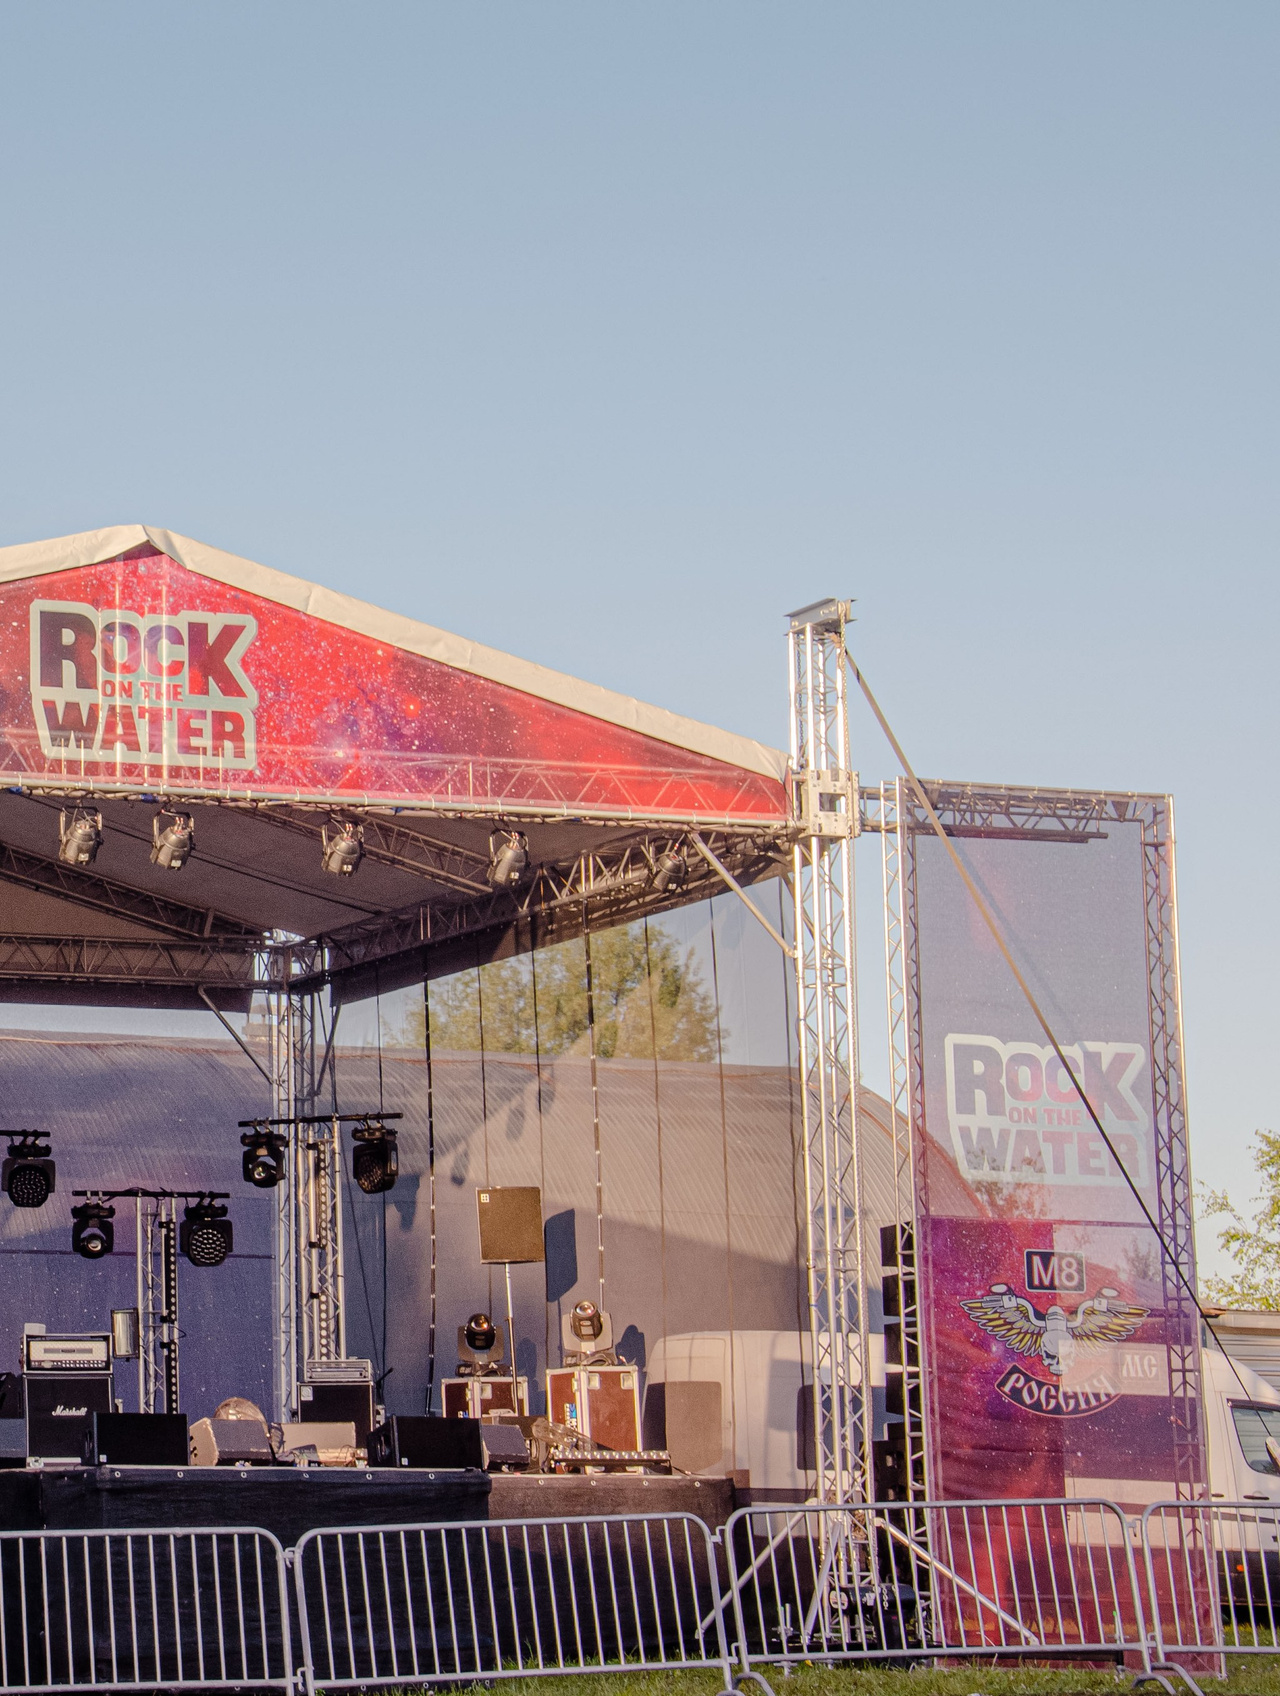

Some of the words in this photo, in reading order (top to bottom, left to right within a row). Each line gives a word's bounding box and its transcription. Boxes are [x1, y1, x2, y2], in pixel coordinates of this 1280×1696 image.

[39, 610, 246, 698] ROCK
[102, 679, 133, 699] ON
[140, 681, 184, 702] THE
[43, 700, 246, 759] WATER
[954, 1045, 1138, 1122] ROCK
[1008, 1106, 1038, 1125] ON
[1043, 1107, 1081, 1126] THE
[958, 1125, 1141, 1179] WATER
[1031, 1257, 1079, 1288] M8
[52, 1405, 88, 1416] Marshall
[1002, 1373, 1119, 1412] РОССИЯ
